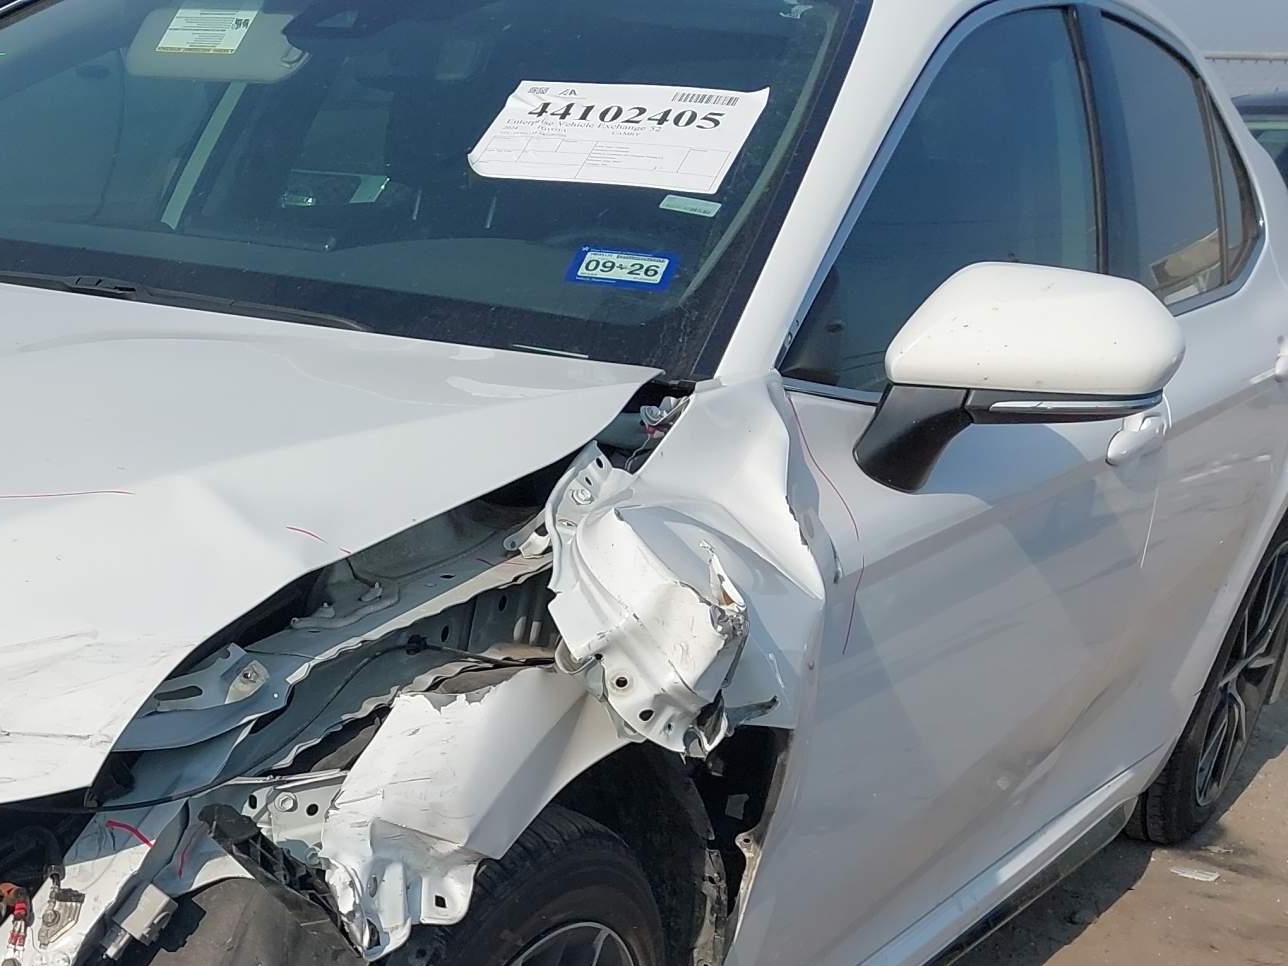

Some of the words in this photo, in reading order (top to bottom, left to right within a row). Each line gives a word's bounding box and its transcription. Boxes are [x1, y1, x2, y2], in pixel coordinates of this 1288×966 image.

[528, 102, 726, 130] 44102405
[558, 120, 595, 129] Vehicle
[597, 122, 647, 132] Exchange
